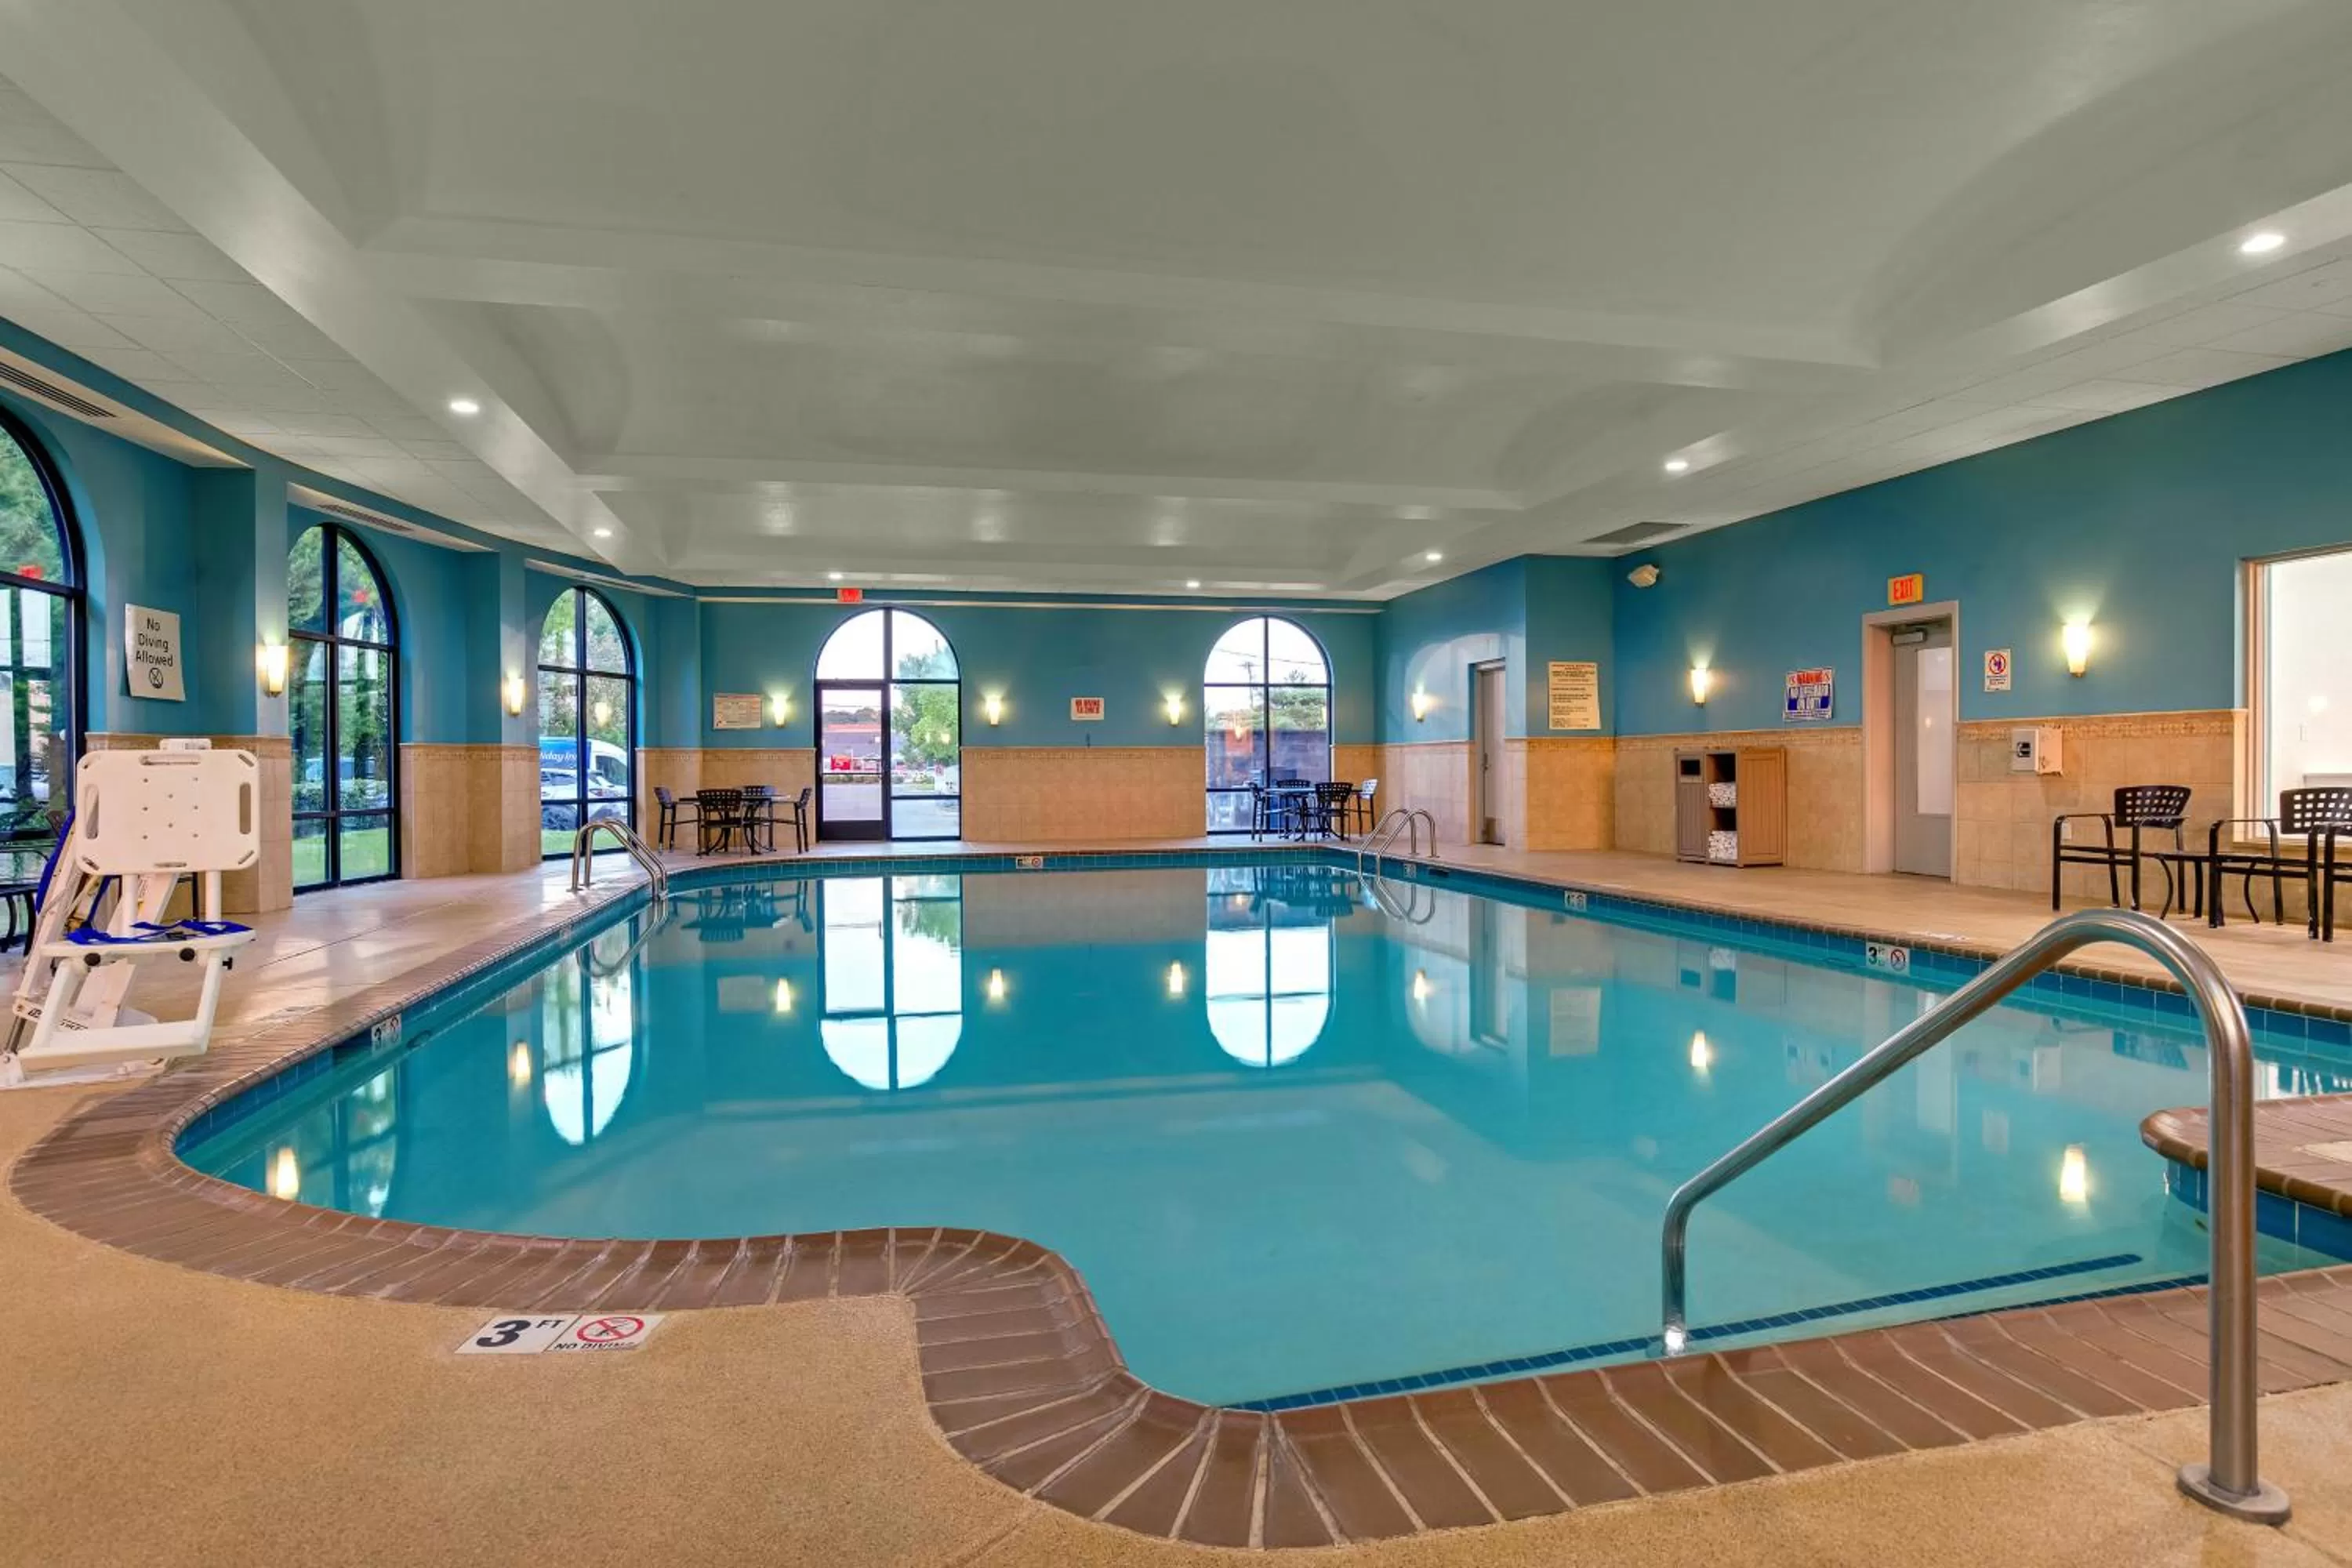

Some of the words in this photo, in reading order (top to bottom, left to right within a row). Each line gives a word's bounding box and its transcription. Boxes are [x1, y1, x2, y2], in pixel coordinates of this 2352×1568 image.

[1893, 576, 1914, 601] EXIT
[147, 617, 161, 630] No
[137, 633, 169, 653] Diving
[135, 650, 173, 667] Allowed
[476, 1319, 531, 1347] 3
[535, 1319, 565, 1328] FT
